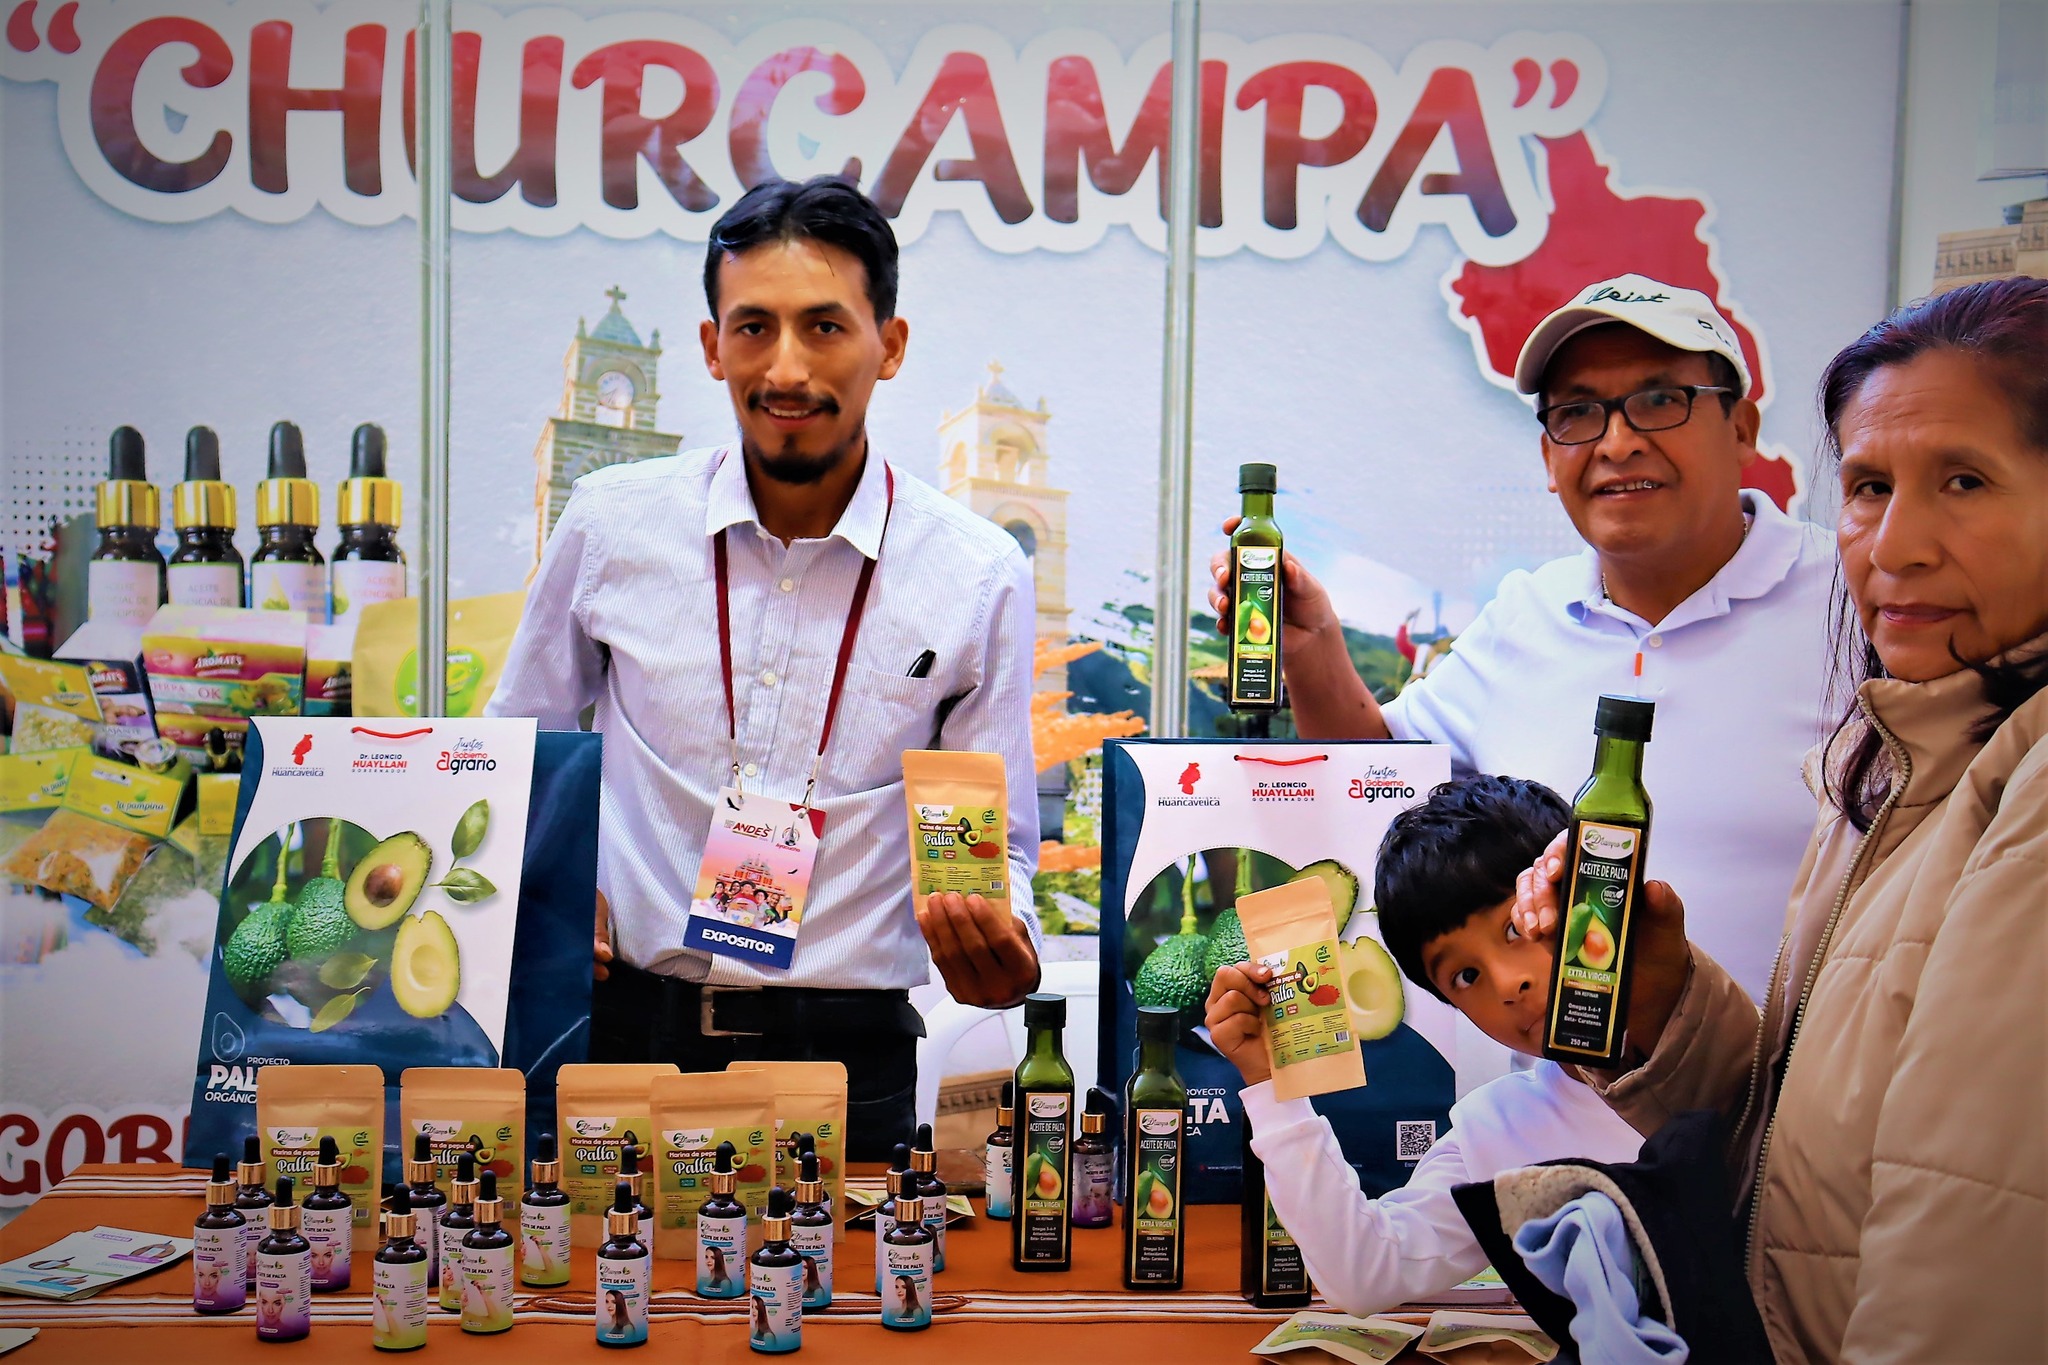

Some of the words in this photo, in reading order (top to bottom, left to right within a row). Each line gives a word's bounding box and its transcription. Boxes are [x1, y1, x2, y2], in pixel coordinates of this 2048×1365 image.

[198, 684, 223, 701] OK
[453, 751, 488, 759] Gobierno
[352, 760, 408, 768] HUAYLLANI
[1364, 779, 1405, 787] Gobierno
[1252, 788, 1315, 797] HUAYLLANI
[733, 822, 770, 838] ANDES
[923, 831, 954, 847] Palta
[1579, 862, 1601, 876] ACEITE
[1600, 865, 1609, 878] DE
[1609, 866, 1628, 880] PALTA
[701, 928, 776, 955] EXPOSITOR
[1567, 968, 1587, 979] EXTRA
[1587, 971, 1611, 982] VIRGEN
[1568, 1003, 1587, 1011] Omegas
[1570, 1038, 1581, 1046] 250
[246, 1056, 291, 1066] PROYECTO
[206, 1064, 260, 1092] PAL
[204, 1091, 258, 1104] ORGÁNIC
[1186, 1088, 1227, 1096] ROYECTO
[1029, 1122, 1045, 1132] ACEITE
[1045, 1122, 1052, 1132] DE
[1052, 1122, 1066, 1132] PALTA
[602, 1139, 619, 1147] pepa
[1139, 1140, 1156, 1149] ACEITE
[1156, 1140, 1163, 1149] DE
[1163, 1140, 1177, 1149] PALTA
[0, 1113, 190, 1196] GOB
[430, 1149, 460, 1166] alta
[575, 1145, 617, 1162] Palta
[669, 1151, 690, 1159] Harina
[673, 1158, 713, 1175] Palta
